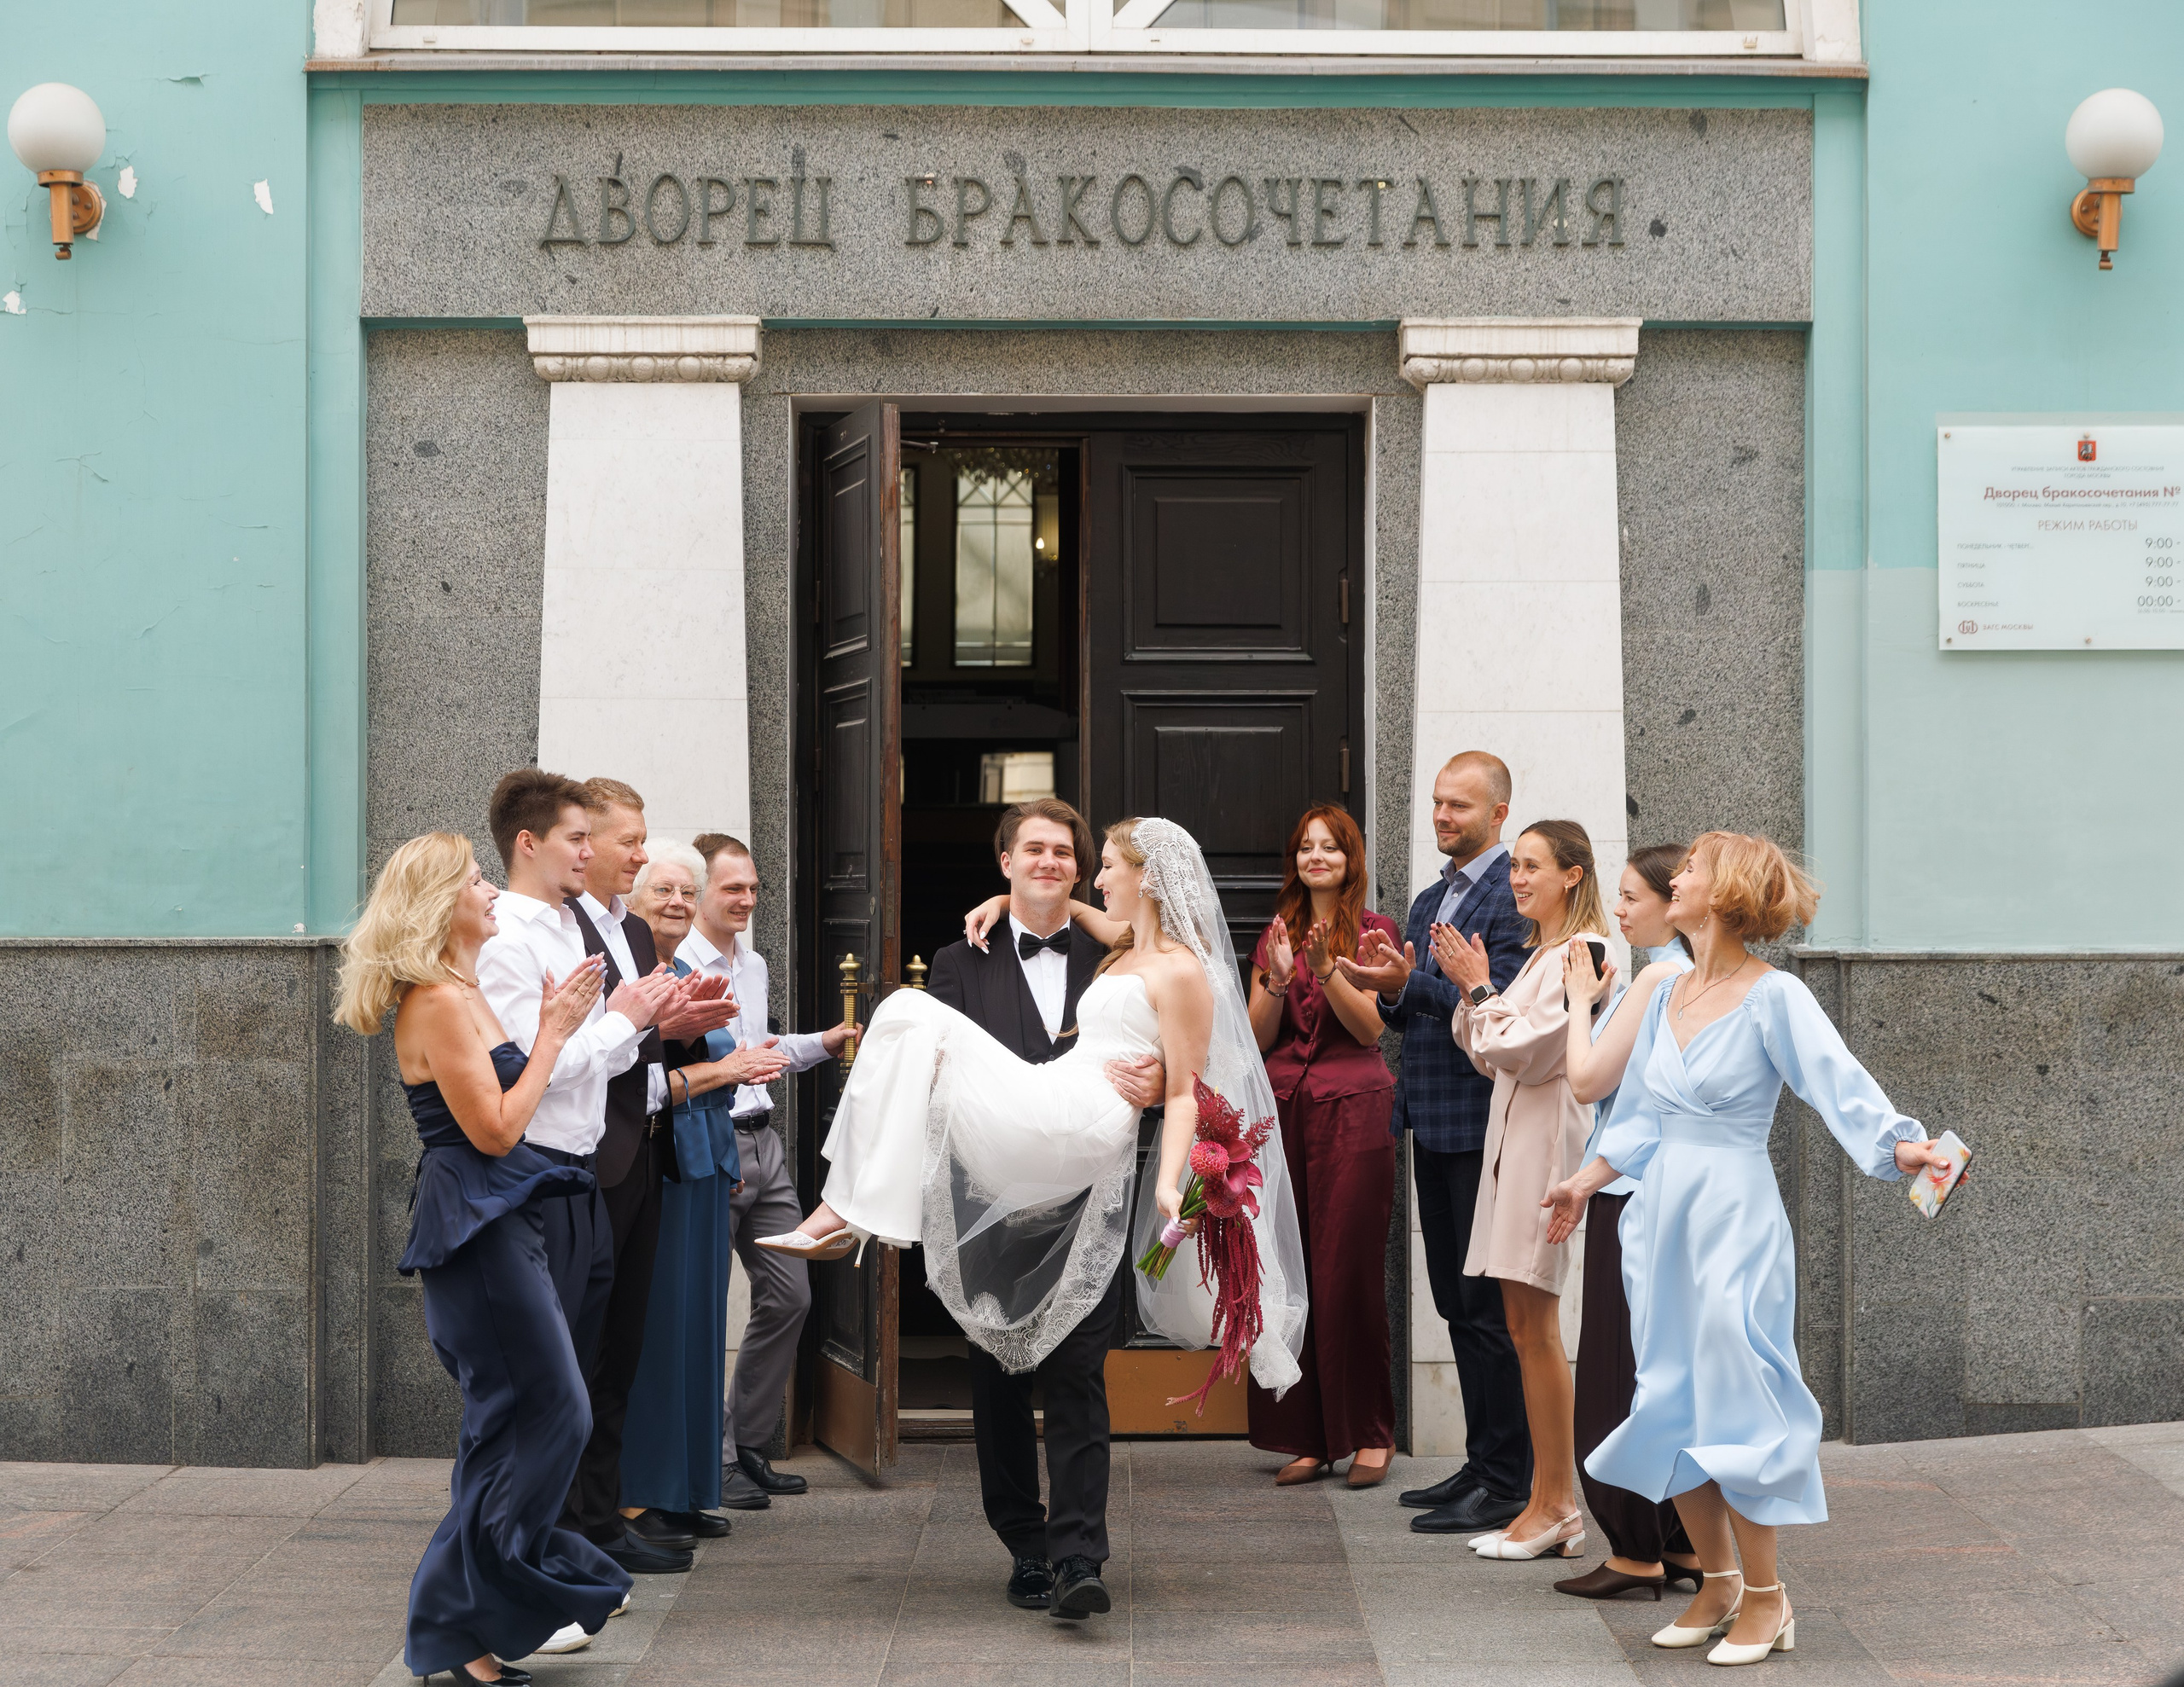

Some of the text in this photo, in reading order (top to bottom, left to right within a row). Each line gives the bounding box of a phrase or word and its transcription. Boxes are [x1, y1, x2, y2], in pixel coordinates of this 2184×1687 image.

[537, 172, 1625, 252] ДВОРЕЦ БРАКОСОЧЕТАНИЯ
[1984, 486, 2039, 501] Дворец
[2042, 485, 2159, 501] бракосочетания
[2037, 519, 2137, 530] РЕЖИМ РАБОТЫ
[2145, 537, 2173, 549] 9:00
[2146, 556, 2173, 568] 9:00
[2145, 576, 2173, 588] 9:00
[2137, 595, 2173, 607] 00:00
